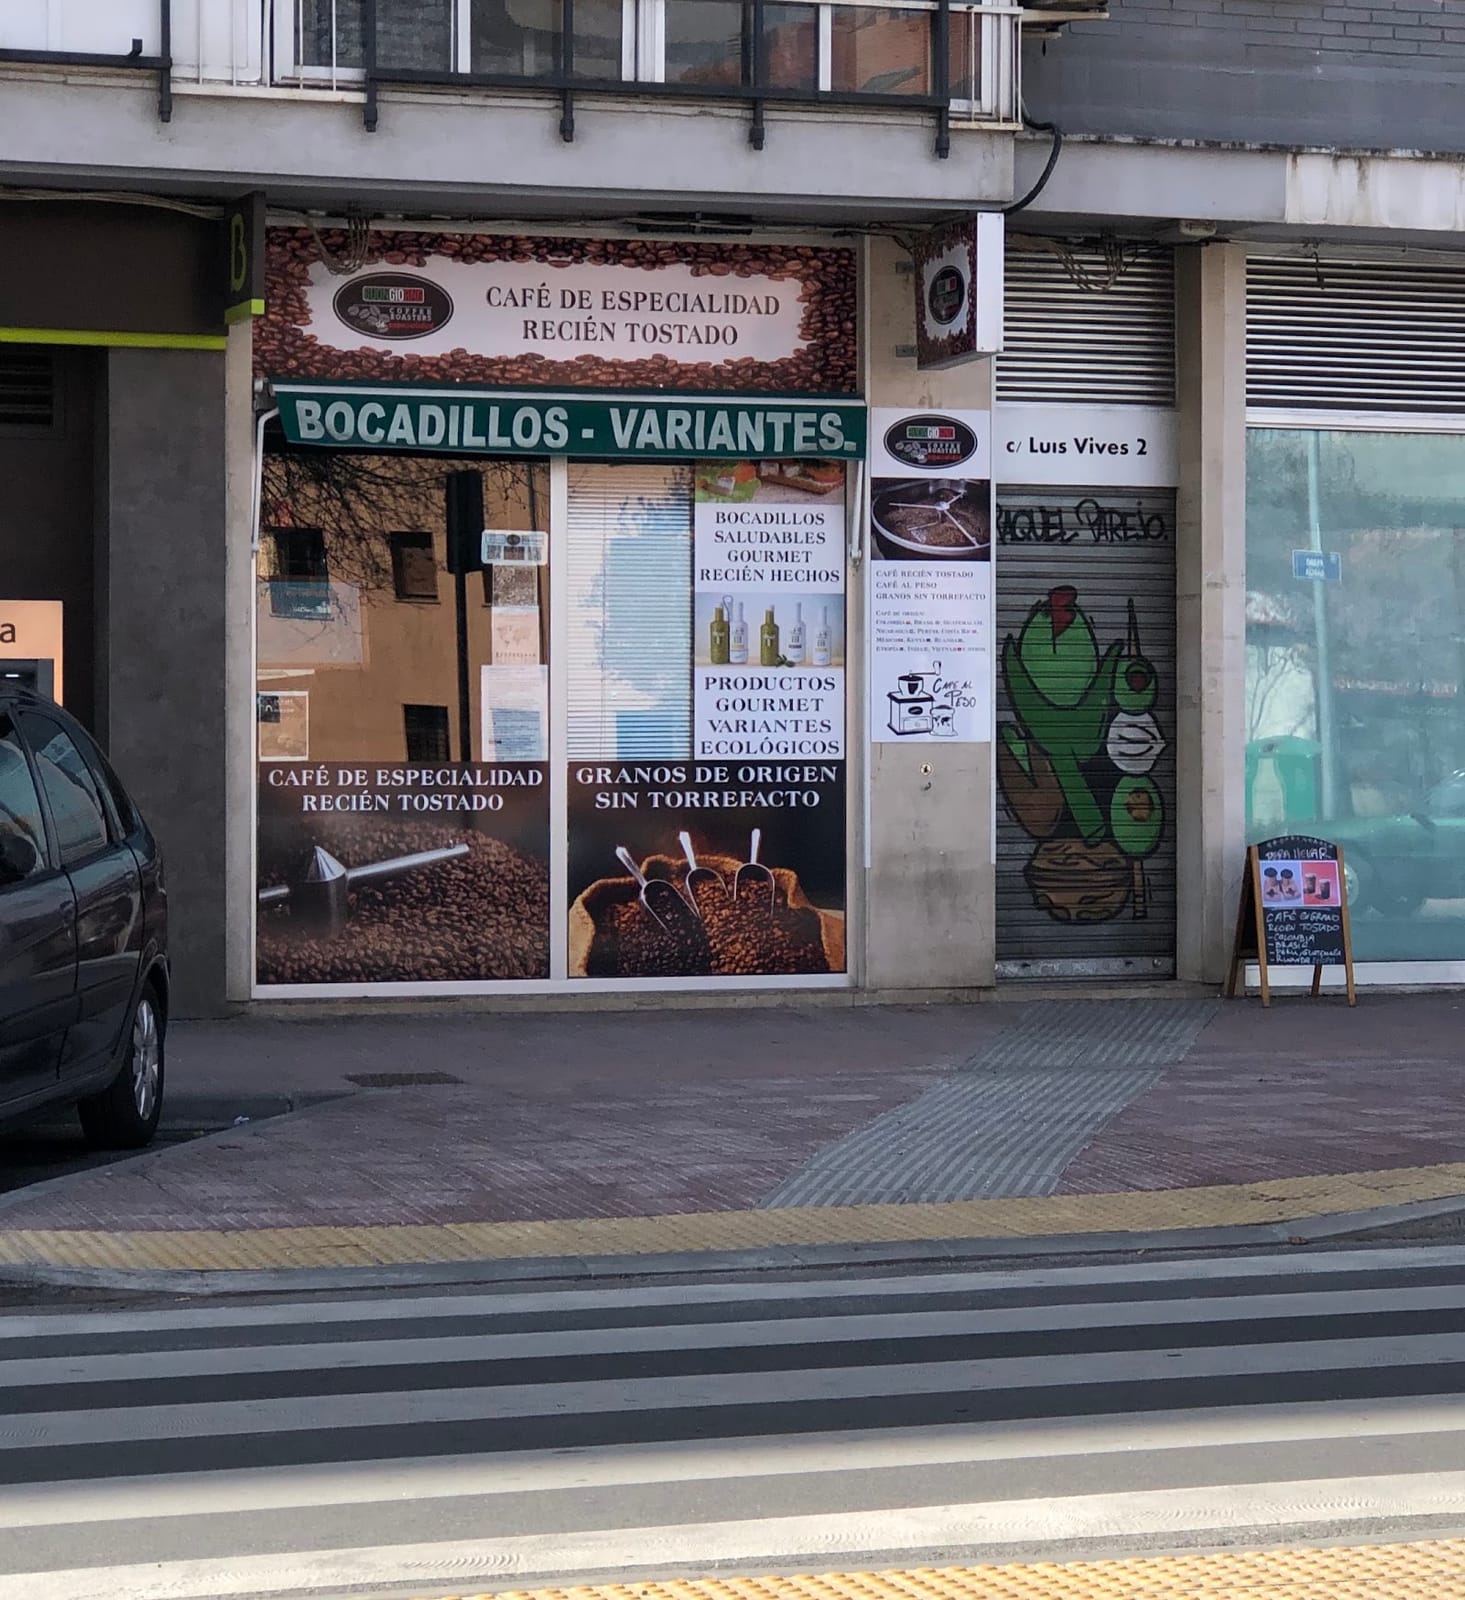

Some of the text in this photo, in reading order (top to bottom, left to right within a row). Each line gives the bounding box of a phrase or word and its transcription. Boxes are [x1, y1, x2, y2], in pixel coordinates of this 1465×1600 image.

[486, 282, 780, 316] CAFÉ DE ESPECIALIDAD
[522, 315, 738, 346] RECIÉN TOSTADO
[296, 399, 569, 449] BOCADILLOS
[609, 407, 857, 454] VARIANTES.
[1073, 437, 1129, 456] Vives
[1136, 438, 1147, 456] 2
[715, 511, 826, 525] BOCADILLOS
[714, 530, 827, 545] SALUDABLES
[727, 549, 813, 563] GOURMET
[700, 565, 840, 583] RECIÉN HECHOS
[875, 569, 898, 577] CAFÉ
[935, 570, 974, 578] TOSTADO
[875, 580, 898, 588] CAFÉ
[704, 676, 836, 691] PRODUCTOS
[716, 698, 824, 712] GOURMET
[708, 719, 832, 734] VARIANTES
[700, 736, 840, 755] ECOLÓGICOS
[268, 765, 543, 787] CAFÉ DE ESPECIALIDAD
[575, 766, 838, 785] GRANOS DE ORIGEN
[302, 790, 504, 812] RECIÉN TOSTADO
[594, 790, 820, 809] SIN TORREFACTO
